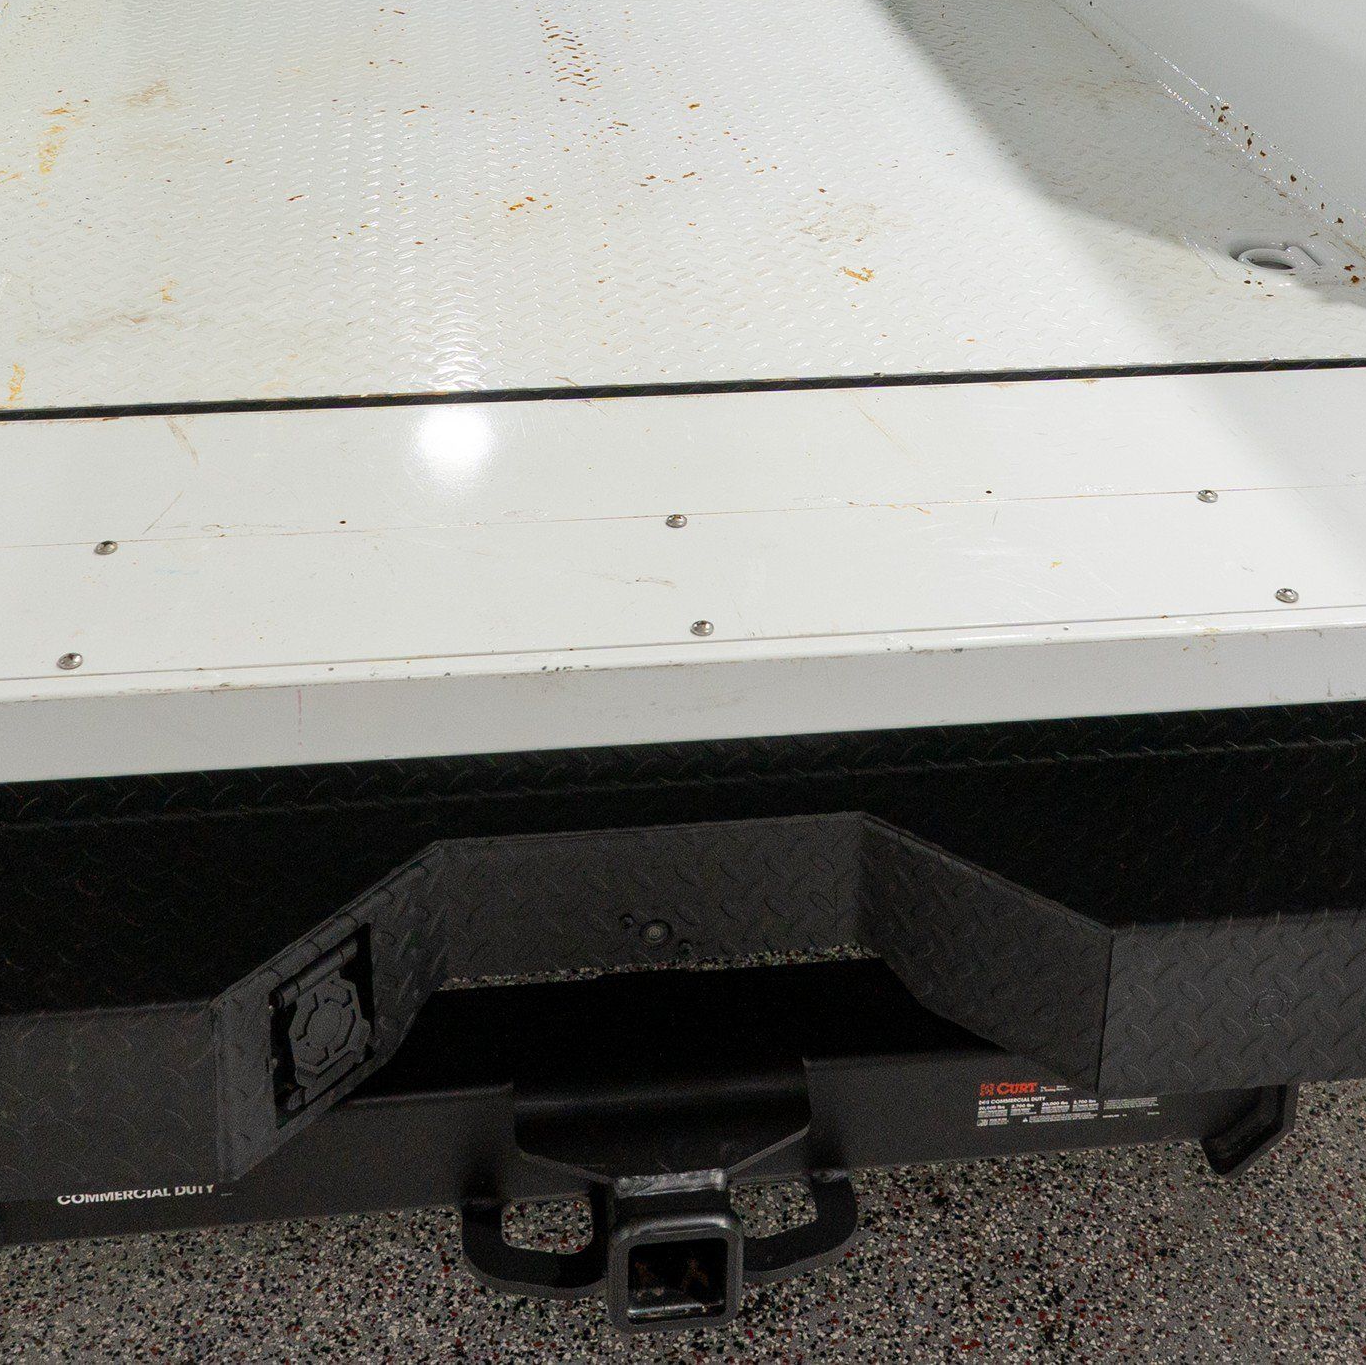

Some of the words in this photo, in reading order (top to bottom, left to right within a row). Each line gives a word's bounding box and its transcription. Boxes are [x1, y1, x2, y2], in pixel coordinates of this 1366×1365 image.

[996, 1082, 1038, 1095] CURT
[57, 1187, 171, 1205] COMMERCIAL
[174, 1184, 215, 1197] DUTY
